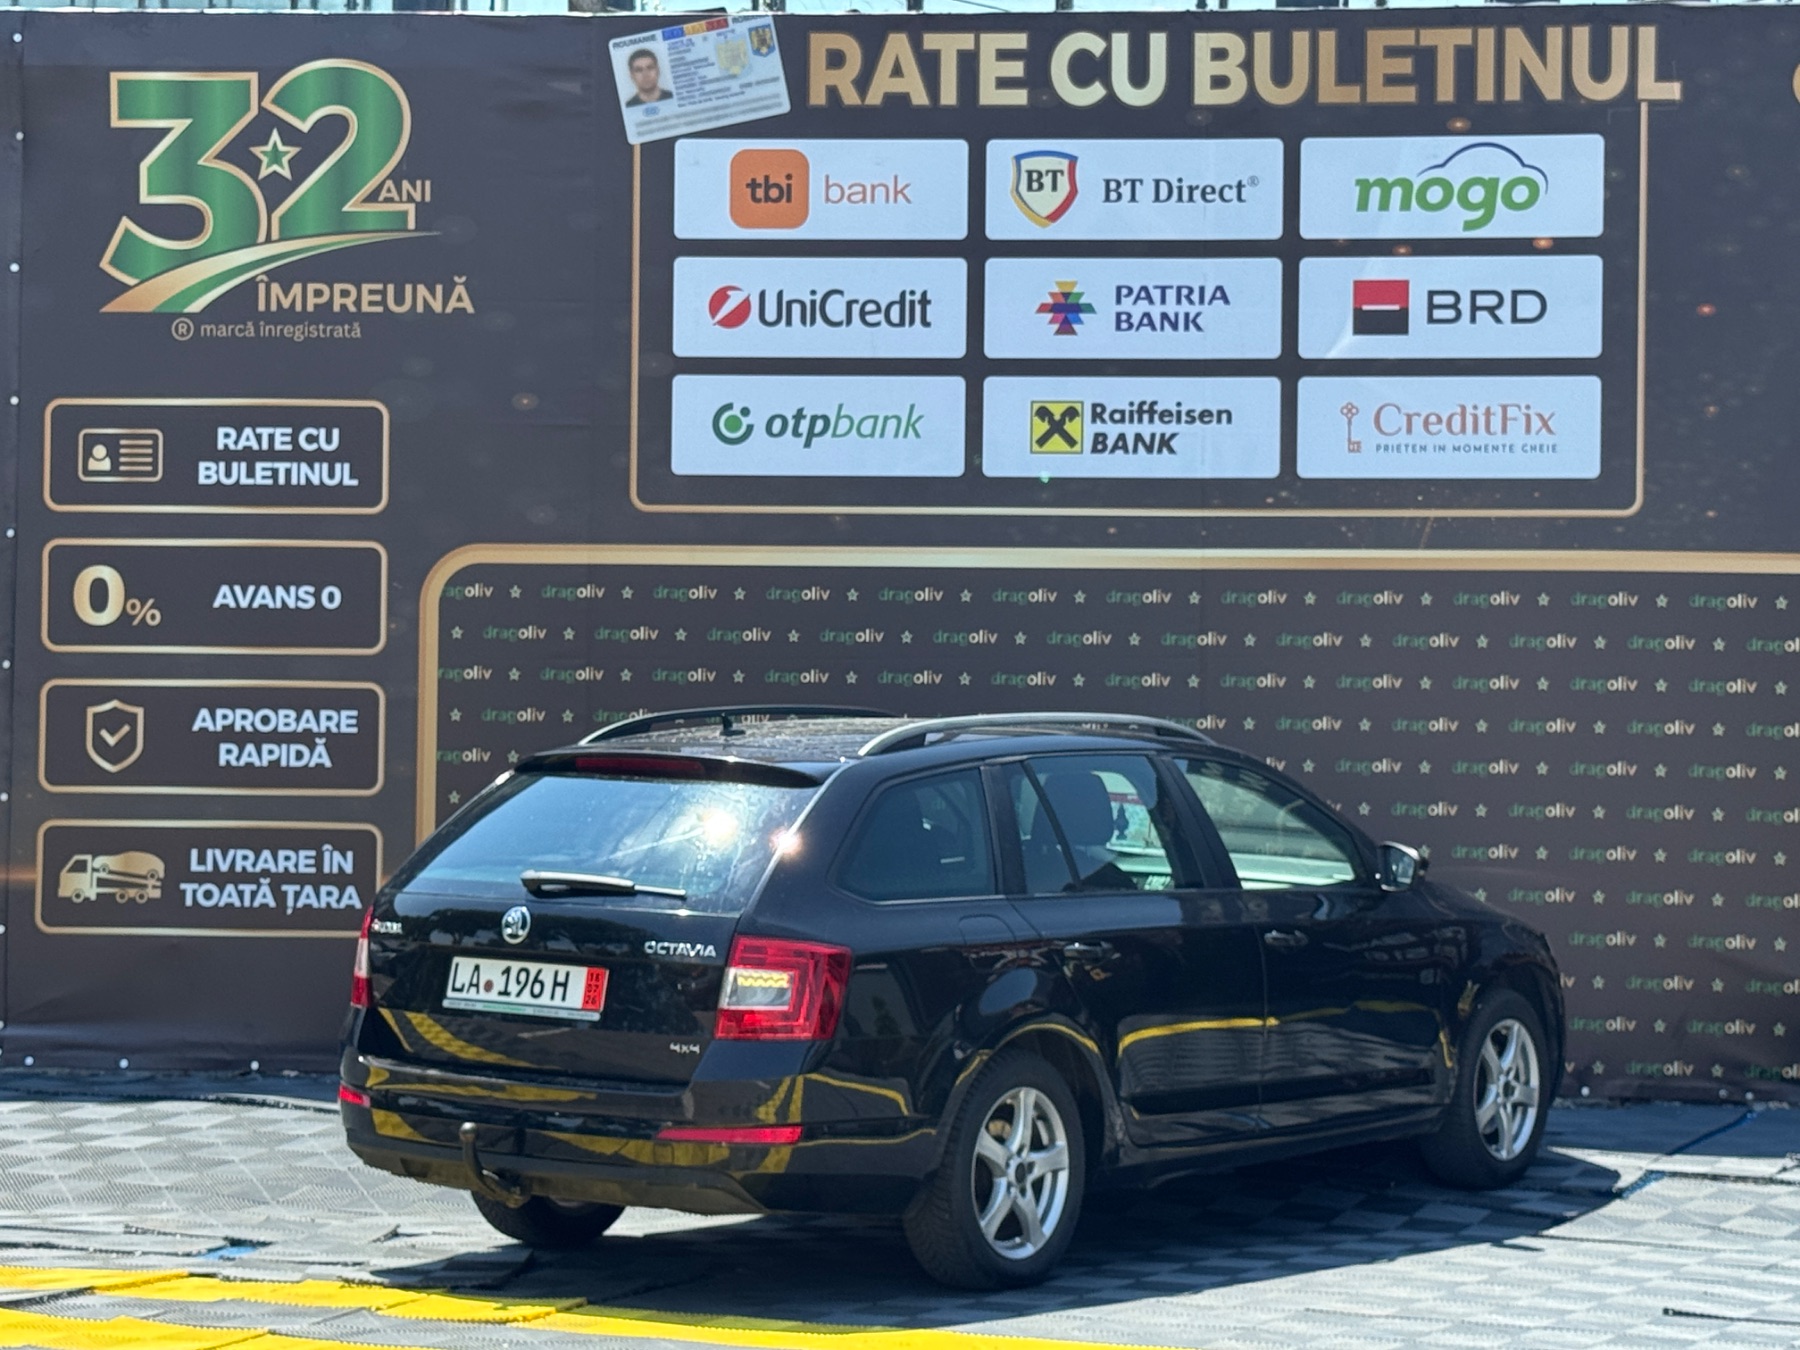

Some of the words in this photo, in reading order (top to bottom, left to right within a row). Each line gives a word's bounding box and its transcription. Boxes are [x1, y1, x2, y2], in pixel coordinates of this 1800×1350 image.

[807, 30, 1029, 108] RATE
[1050, 30, 1168, 107] CU
[1192, 25, 1682, 105] BULETINUL
[100, 58, 415, 286] 32
[1025, 169, 1064, 192] BT
[377, 180, 431, 203] ANI
[745, 173, 794, 204] tbi
[824, 174, 912, 204] bank
[1102, 178, 1144, 203] BT
[1354, 175, 1540, 232] mogo
[256, 276, 475, 314] ÎMPREUNĂ
[1114, 285, 1231, 306] PATRIA
[1426, 289, 1549, 325] BRD
[758, 288, 932, 329] UniCredit
[1114, 311, 1205, 332] BANK
[200, 321, 255, 338] marcă
[260, 319, 361, 342] înregistrată
[1090, 400, 1233, 425] Raiffeisen
[1373, 403, 1556, 437] CreditFix
[765, 404, 925, 448] otpbank
[217, 427, 292, 452] RATE
[298, 427, 340, 452] CU
[1090, 432, 1180, 455] BANK
[1375, 443, 1427, 454] PRIETEN
[1433, 443, 1446, 454] IN
[1452, 443, 1515, 454] MOMENTE
[1521, 443, 1558, 454] CHEIE
[199, 461, 359, 487] BULETINUL
[213, 585, 316, 609] AVANS
[321, 585, 342, 609] 0
[444, 584, 493, 600] agoliv
[541, 584, 607, 601] dragoliv
[653, 586, 719, 601] dragoliv
[766, 587, 832, 602] dragoliv
[878, 587, 945, 603] dragoliv
[993, 589, 1059, 604] dragoliv
[1108, 589, 1173, 605] dragoliv
[1222, 590, 1289, 607] dragoliv
[1336, 591, 1405, 606] dragoliv
[1453, 591, 1522, 607] dragoliv
[1570, 592, 1640, 609] dragoliv
[1688, 594, 1759, 610] dragoliv
[483, 626, 548, 641] dragoliv
[596, 626, 660, 642] dragoliv
[707, 628, 773, 643] dragoliv
[820, 629, 886, 644] dragoliv
[933, 630, 999, 645] dragoliv
[1047, 631, 1114, 647] dragoliv
[1161, 632, 1229, 648] dragoliv
[1276, 632, 1344, 649] dragoliv
[1392, 633, 1461, 649] dragoliv
[1509, 634, 1578, 651] dragoliv
[1627, 635, 1697, 652] dragoliv
[1746, 637, 1800, 655] dragol
[438, 666, 492, 682] ragoliv
[540, 667, 605, 682] dragoliv
[652, 668, 718, 684] dragoliv
[765, 669, 830, 685] dragoliv
[878, 670, 944, 686] dragoliv
[993, 672, 1058, 687] dragoliv
[1106, 673, 1172, 688] dragoliv
[1221, 673, 1288, 690] dragoliv
[1337, 674, 1404, 690] dragoliv
[1452, 675, 1521, 692] dragoliv
[1569, 676, 1639, 693] dragoliv
[1689, 679, 1759, 695] dragoliv
[192, 707, 359, 734] APROBARE
[481, 708, 547, 723] dragoliv
[1277, 716, 1343, 732] dragoliv
[1392, 717, 1460, 733] dragoliv
[1509, 718, 1578, 735] dragoliv
[1627, 720, 1696, 737] dragoliv
[1747, 723, 1800, 740] dragol
[218, 738, 332, 769] RAPIDĂ
[437, 748, 491, 764] ragoliv
[1337, 759, 1403, 774] dragoliv
[1453, 760, 1520, 776] dragoliv
[1570, 761, 1639, 777] dragoliv
[1689, 764, 1758, 780] dragoliv
[1392, 802, 1459, 818] dragoliv
[1508, 803, 1577, 819] dragoliv
[1627, 805, 1696, 822] dragoliv
[1746, 808, 1800, 826] dragol
[190, 848, 316, 874] LIVRARE
[322, 843, 354, 875] ÎN
[1452, 844, 1520, 861] dragoliv
[1570, 846, 1638, 862] dragoliv
[1687, 849, 1758, 866] dragoliv
[180, 878, 275, 909] TOATĂ
[1508, 888, 1577, 904] dragoliv
[1625, 890, 1696, 907] dragoliv
[1745, 894, 1800, 911] dragol
[644, 940, 716, 957] OCTAVIA
[1570, 931, 1637, 947] dragoliv
[1689, 934, 1757, 951] dragoliv
[451, 962, 481, 995] LA
[1627, 976, 1695, 992] dragoliv
[1746, 980, 1800, 996] dragol
[1569, 1017, 1637, 1033] dragoliv
[1688, 1020, 1757, 1036] dragoliv
[1629, 1061, 1695, 1077] dragoliv
[1747, 1064, 1800, 1081] dragoli
